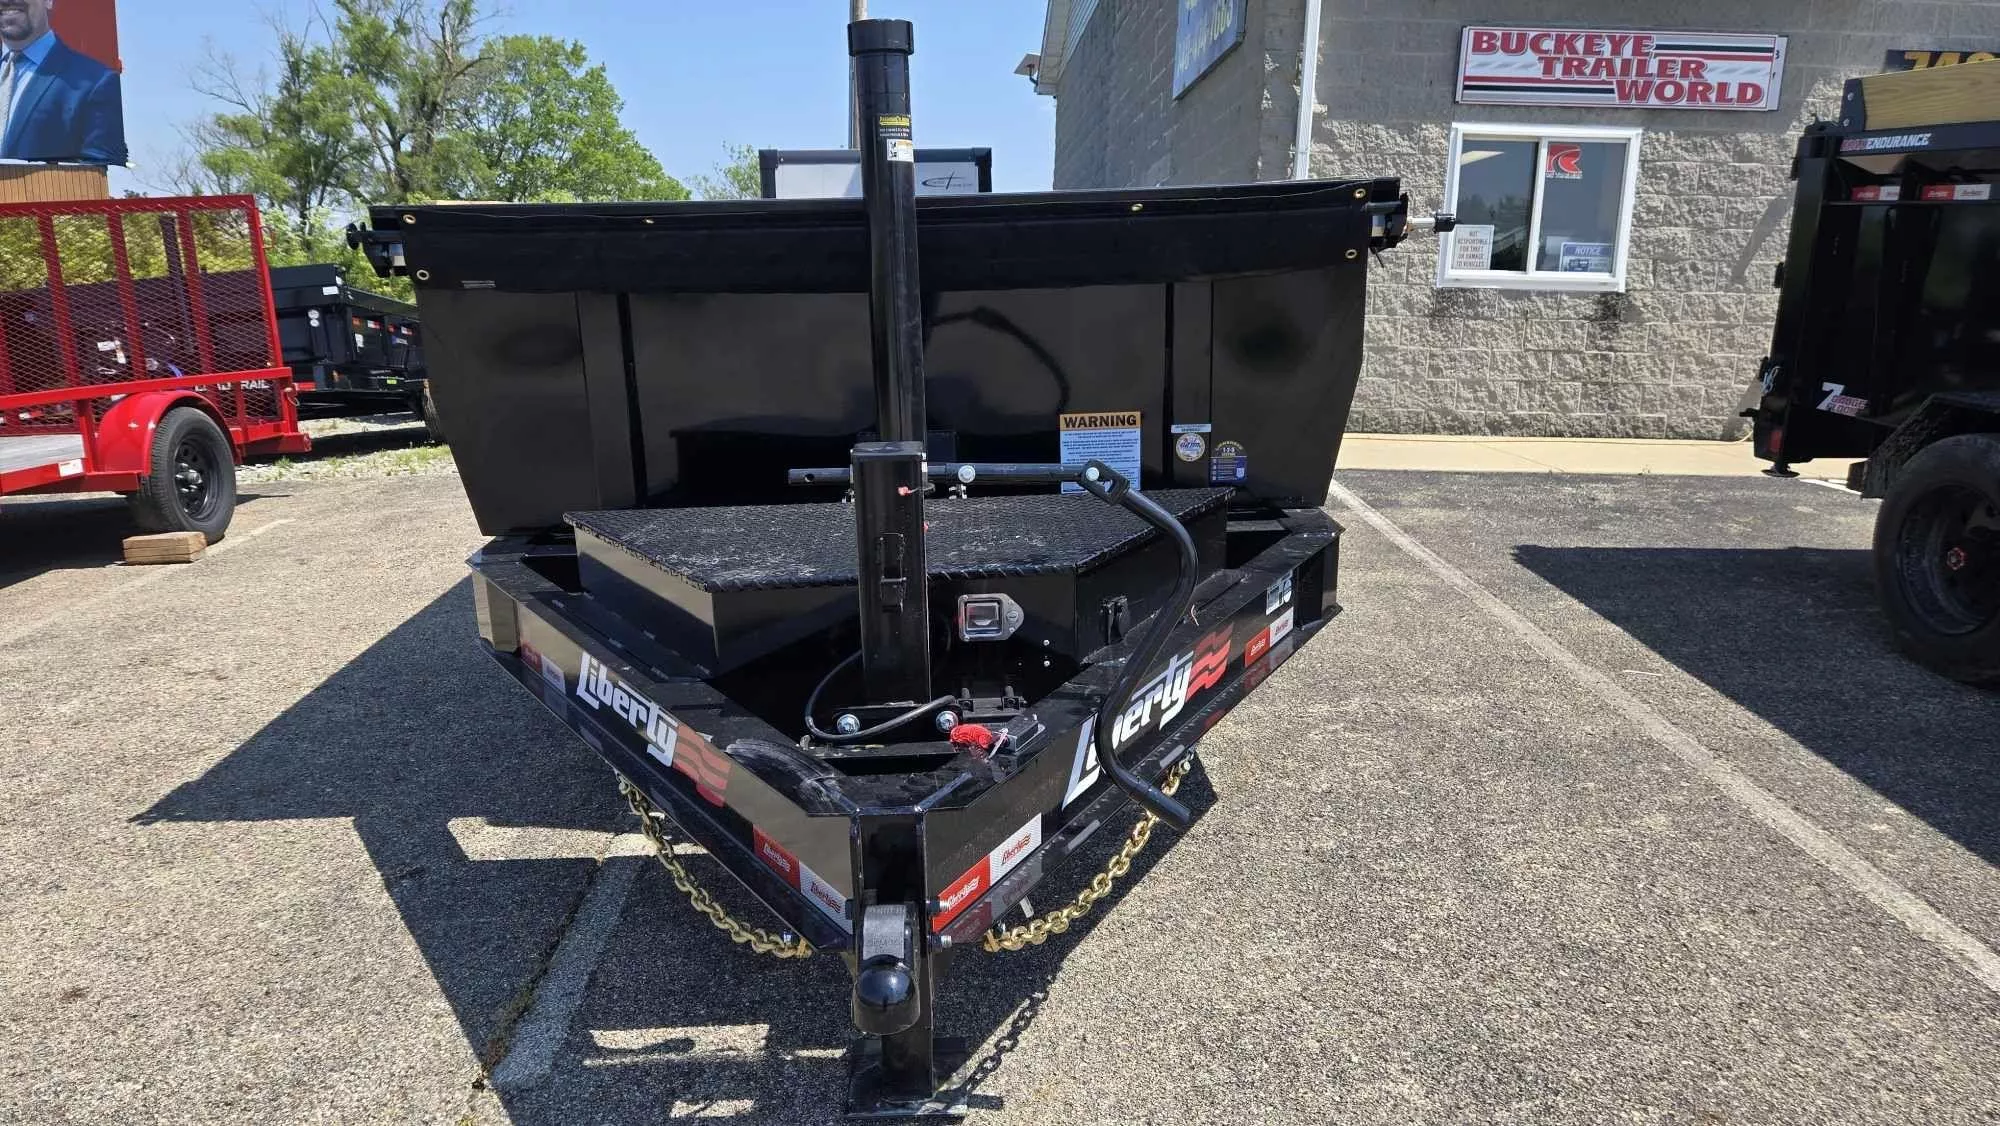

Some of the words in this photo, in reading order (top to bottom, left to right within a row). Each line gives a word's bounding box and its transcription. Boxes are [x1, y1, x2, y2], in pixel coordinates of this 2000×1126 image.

[1472, 31, 1655, 57] BUCKEYE
[1538, 56, 1708, 81] TRAILER
[1614, 79, 1765, 105] WORLD
[1064, 414, 1137, 428] WARNING
[576, 651, 678, 767] Liberty
